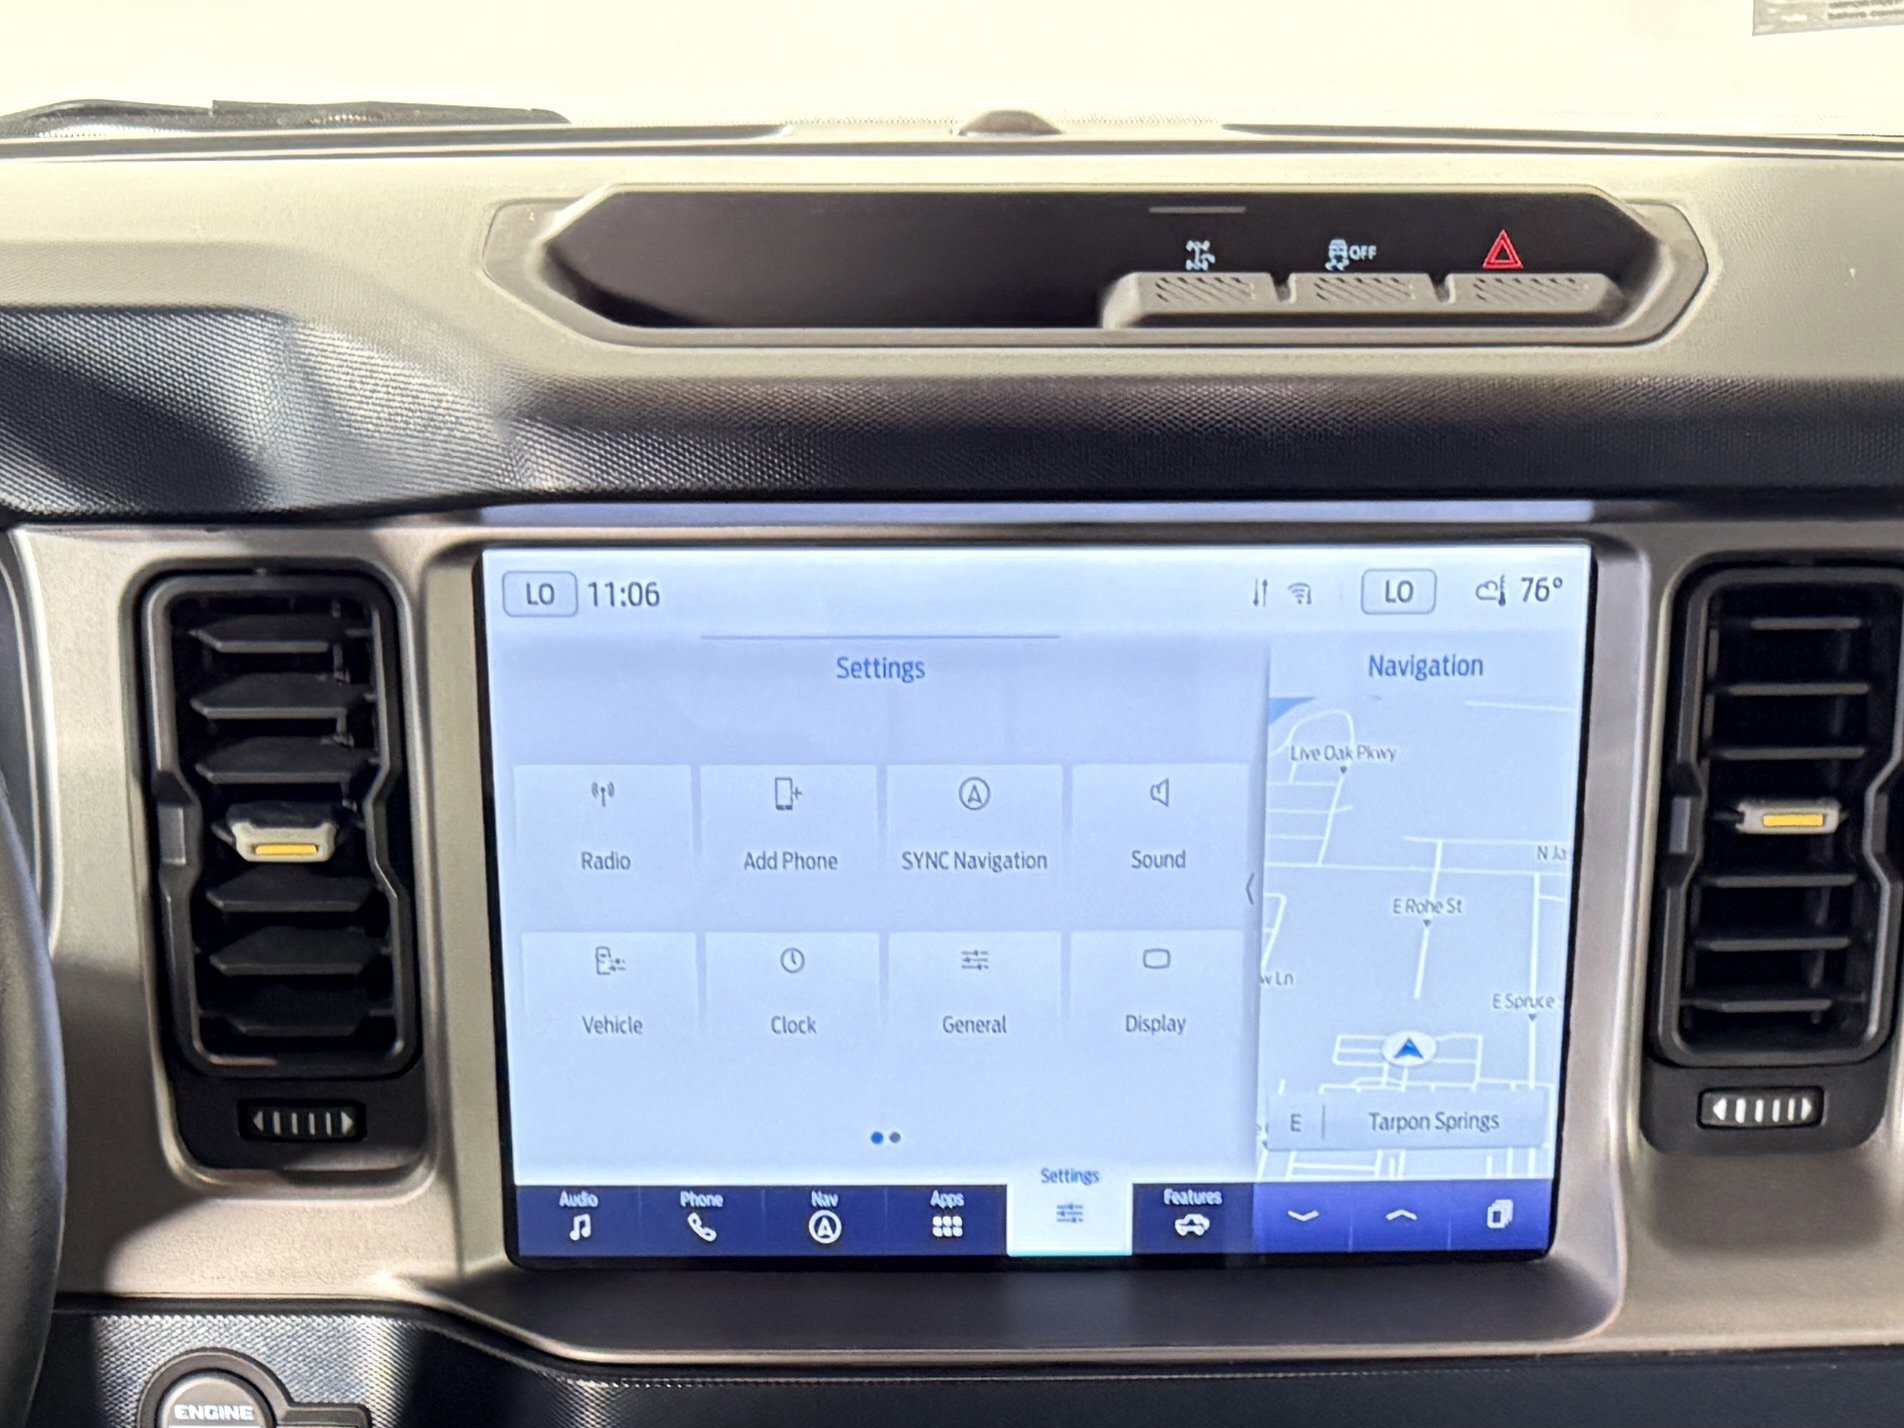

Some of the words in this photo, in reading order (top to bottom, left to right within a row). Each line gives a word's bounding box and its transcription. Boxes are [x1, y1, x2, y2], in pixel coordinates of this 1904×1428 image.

[1349, 245, 1377, 261] OFF
[525, 582, 556, 606] LO
[587, 581, 661, 608] 11:06
[1384, 580, 1414, 603] LO
[1520, 576, 1563, 603] 76°
[836, 656, 926, 684] Settings
[1368, 654, 1484, 682] Navigation
[1290, 744, 1321, 762] Live
[1324, 744, 1353, 762] Oak
[1357, 744, 1396, 764] Pkwy
[580, 851, 632, 871] Radio
[743, 851, 778, 871] Add
[781, 851, 839, 871] Phone
[901, 850, 950, 871] SYNC
[954, 850, 1048, 874] Navigation
[1131, 848, 1187, 870] Sound
[1446, 897, 1463, 914] St
[1505, 993, 1555, 1012] Spruce
[582, 1014, 644, 1035] Vehicle
[770, 1014, 817, 1035] Clock
[942, 1014, 1007, 1035] General
[1124, 1013, 1187, 1036] Display
[1290, 1113, 1302, 1132] E
[1368, 1110, 1431, 1135] Tarpon
[1434, 1110, 1500, 1134] Springs
[1040, 1167, 1100, 1186] Settings
[559, 1190, 599, 1209] Audio
[679, 1190, 724, 1209] Phone
[810, 1190, 839, 1208] Nav
[930, 1190, 965, 1211] Apps
[1163, 1188, 1223, 1206] Features
[174, 1404, 255, 1421] ENGINE
